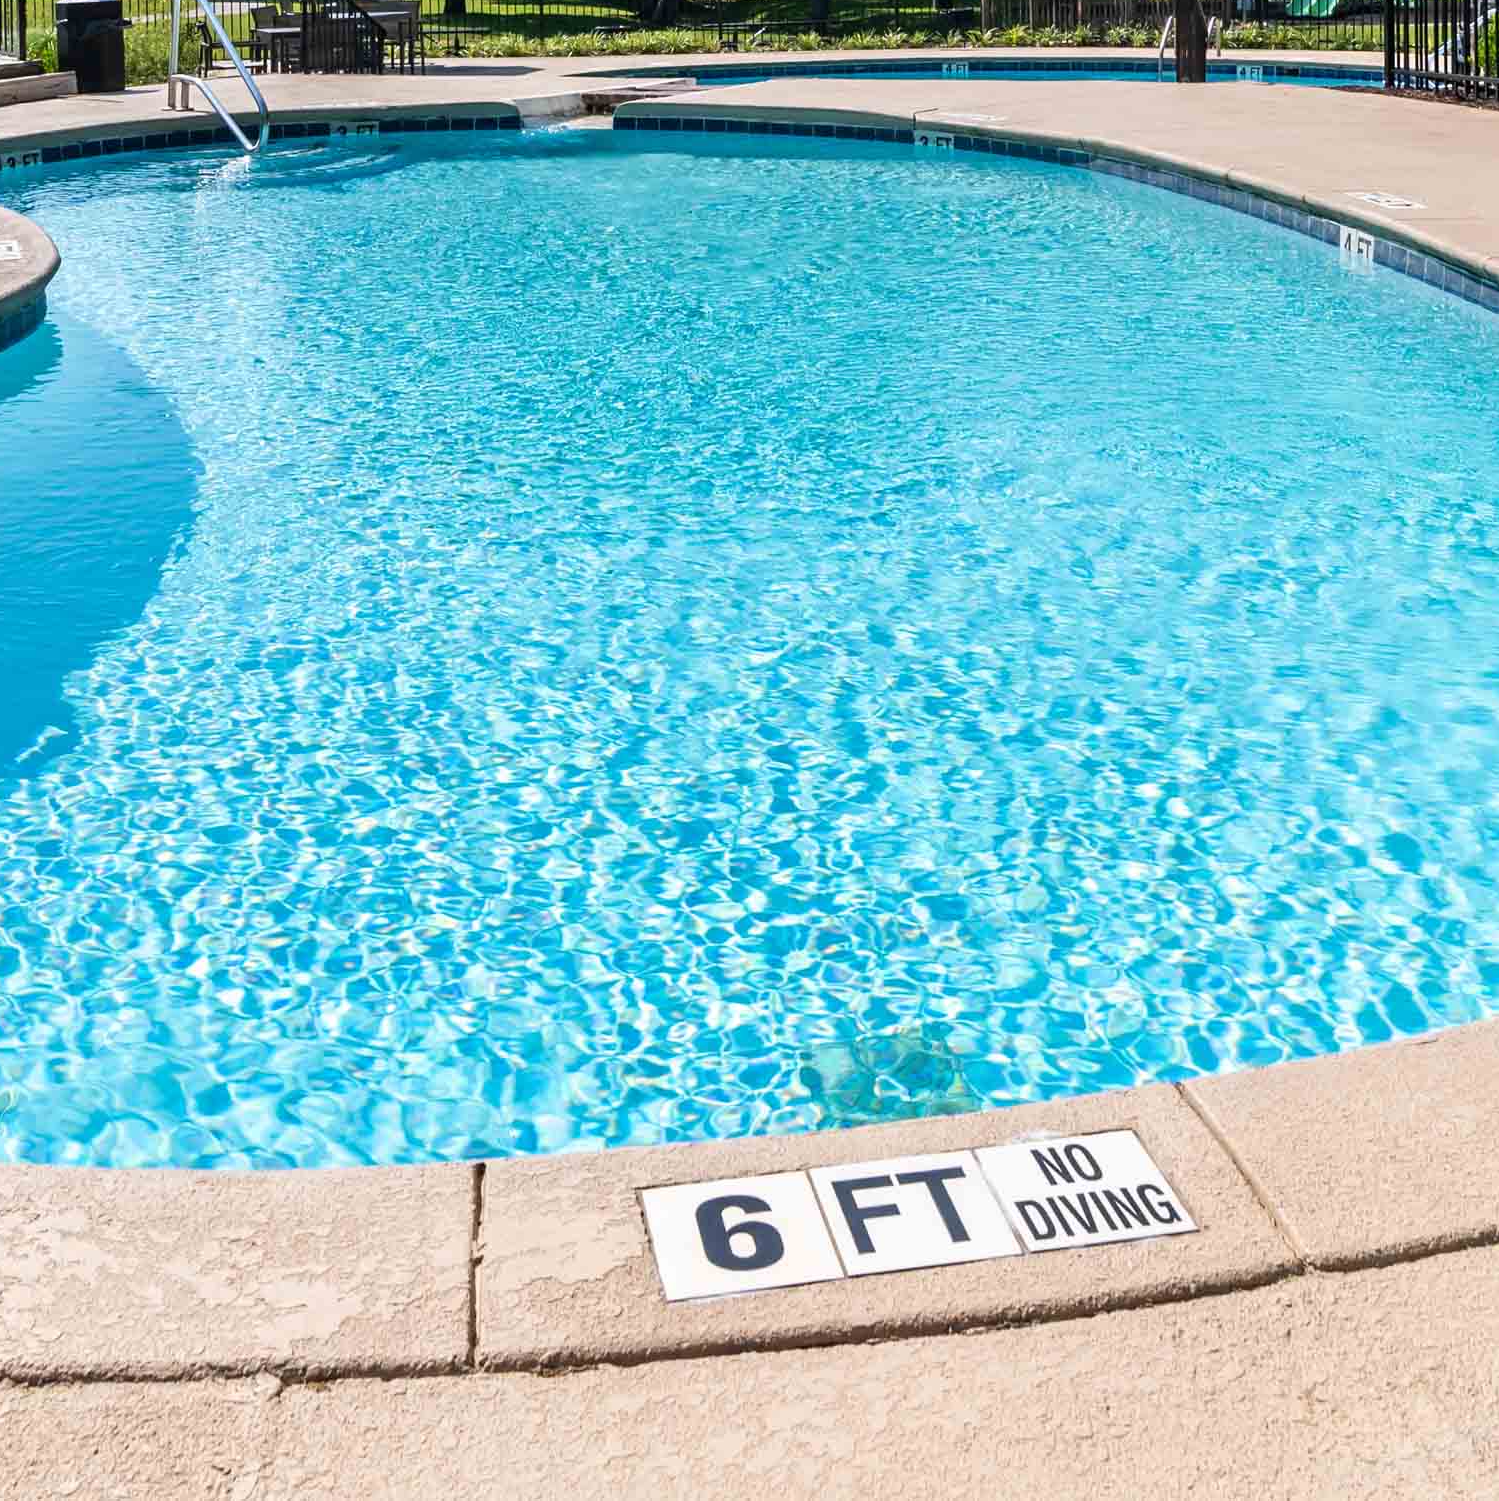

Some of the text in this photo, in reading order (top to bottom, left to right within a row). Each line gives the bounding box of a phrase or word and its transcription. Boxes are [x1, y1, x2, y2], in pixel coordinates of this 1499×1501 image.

[1357, 237, 1372, 258] FT
[1032, 1143, 1103, 1186] NO
[695, 1166, 972, 1272] 6 FT
[1015, 1183, 1183, 1242] DIVING
